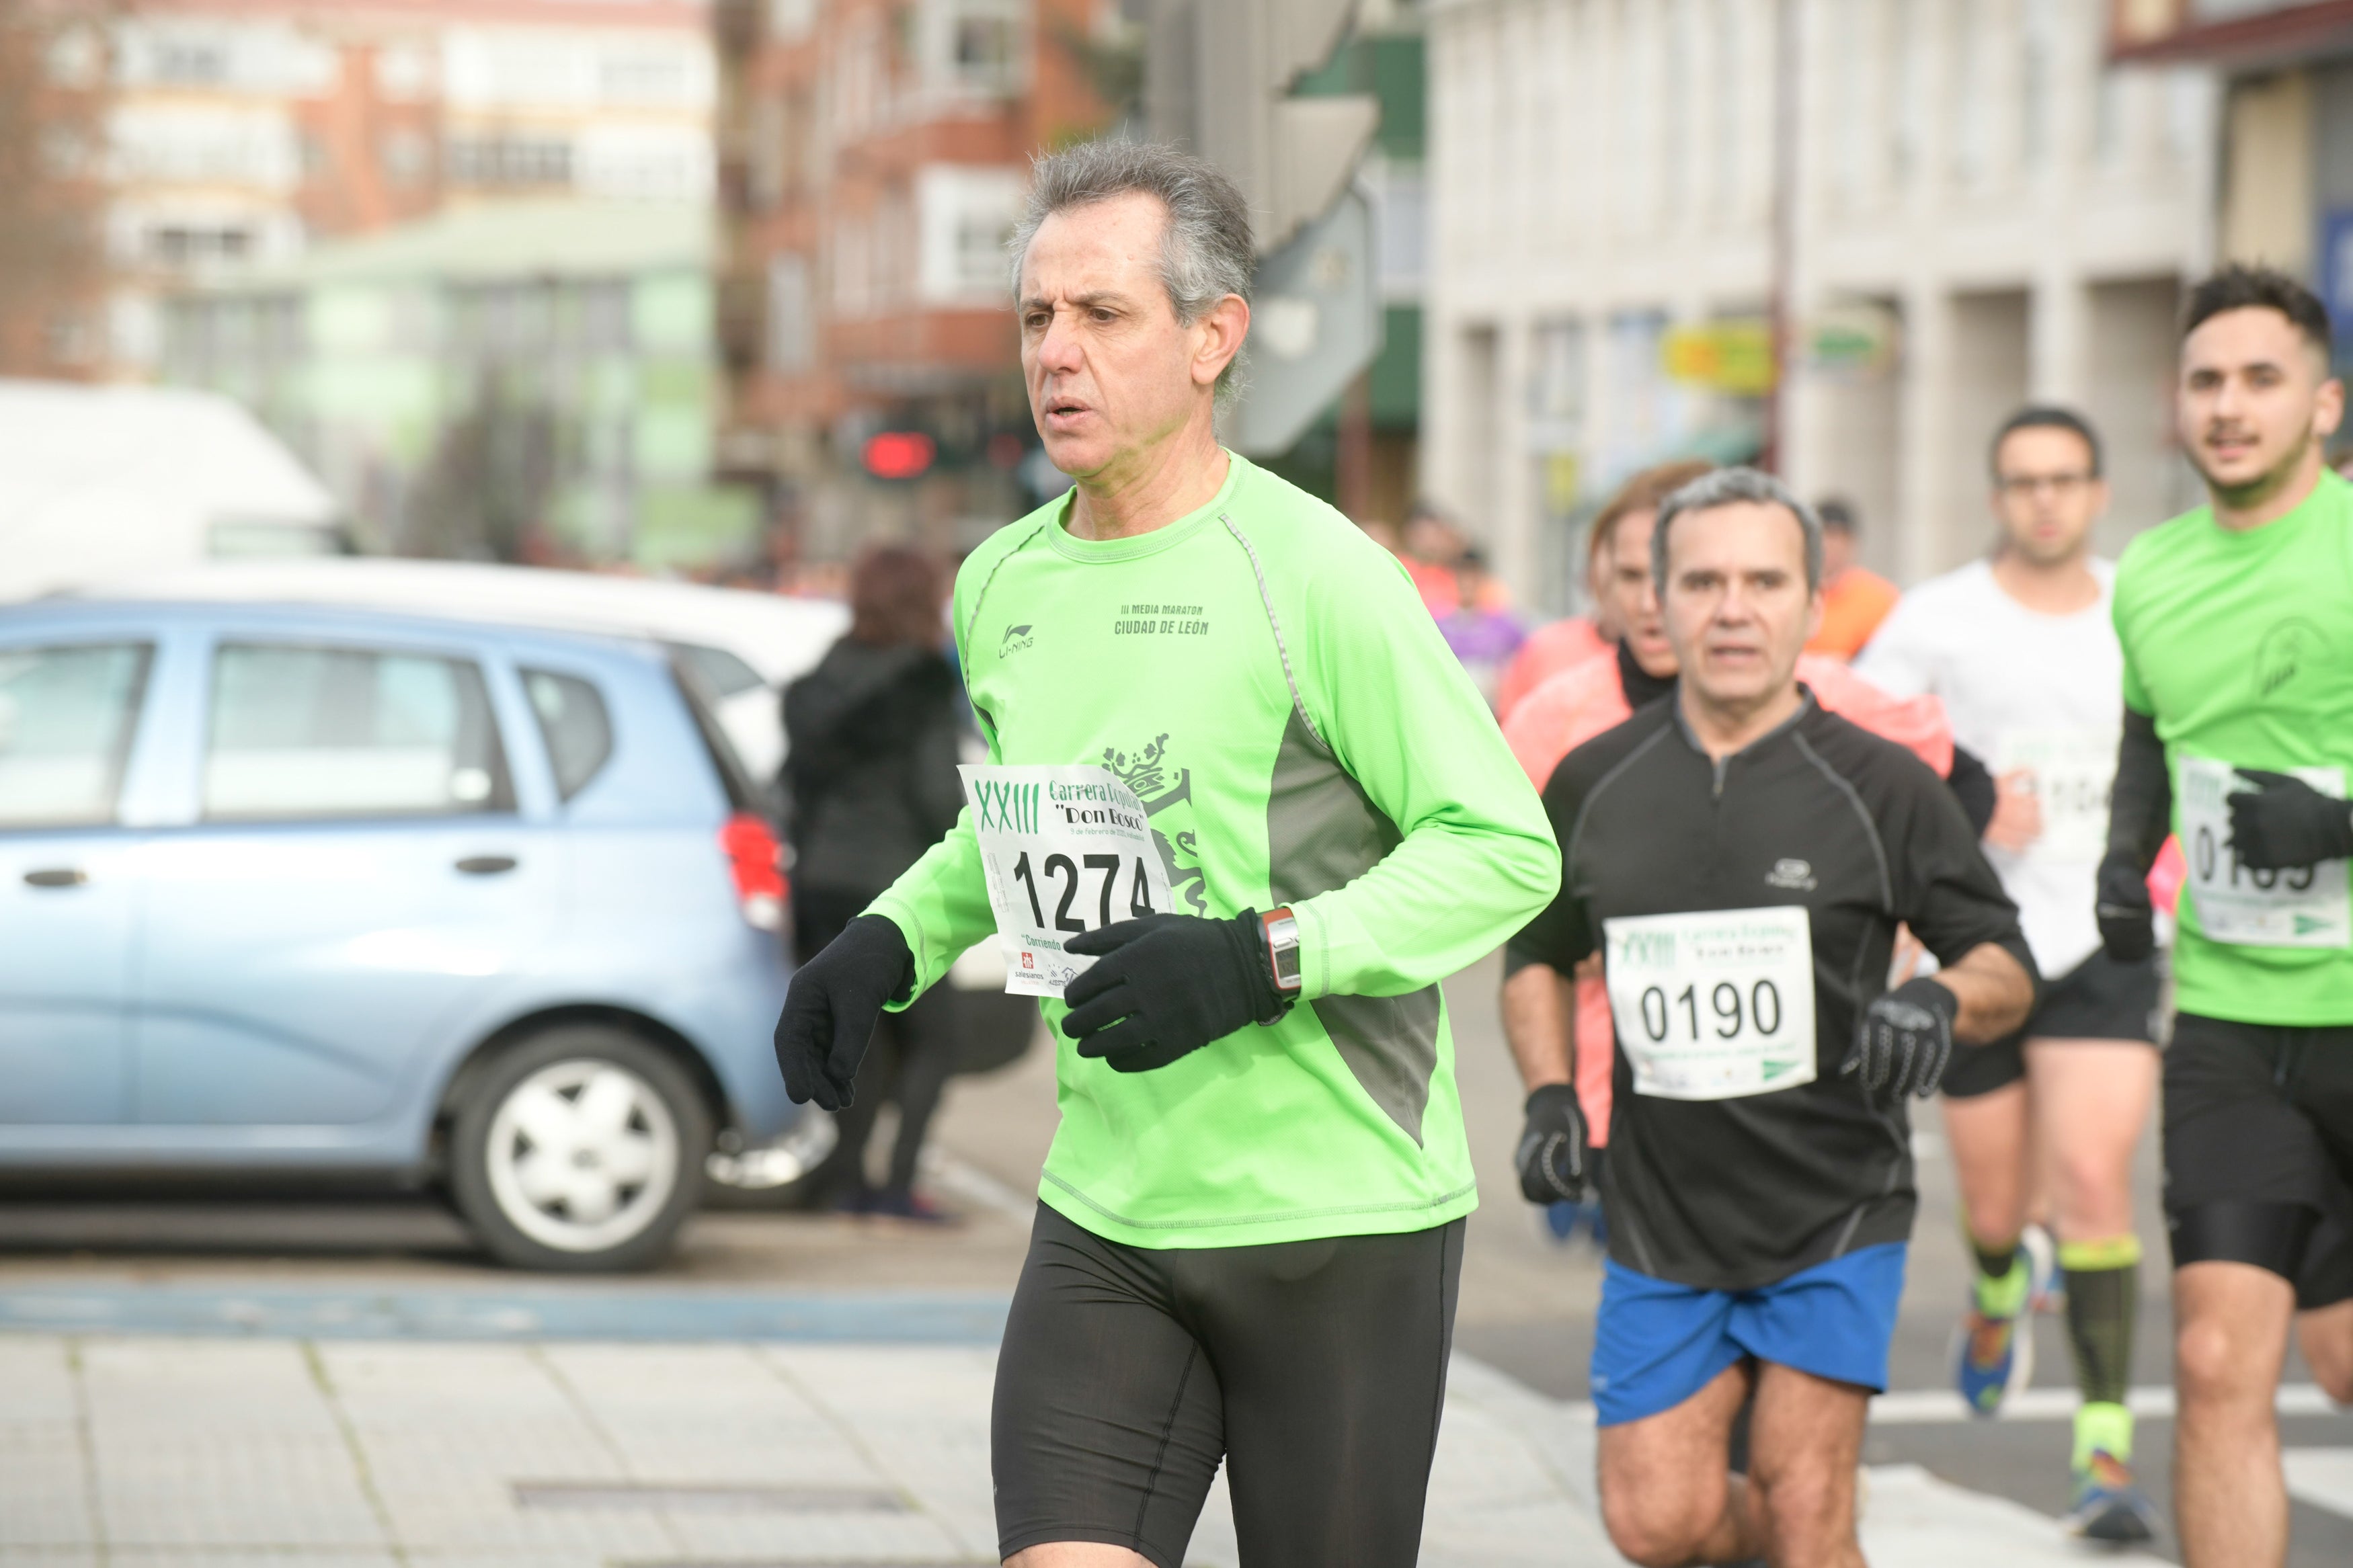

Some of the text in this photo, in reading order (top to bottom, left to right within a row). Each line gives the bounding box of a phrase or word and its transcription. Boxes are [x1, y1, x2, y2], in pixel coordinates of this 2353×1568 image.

[1121, 604, 1203, 616] III MEDIA MARATON
[1114, 618, 1209, 635] CIUDAD DE LEÓN
[999, 637, 1033, 659] LI-NING
[975, 780, 1142, 835] XXIII Carrera Popular
[1085, 827, 1109, 835] febrero
[1014, 851, 1156, 932] 1274
[1015, 971, 1043, 979] salesianos
[1642, 980, 1780, 1042] 0190
